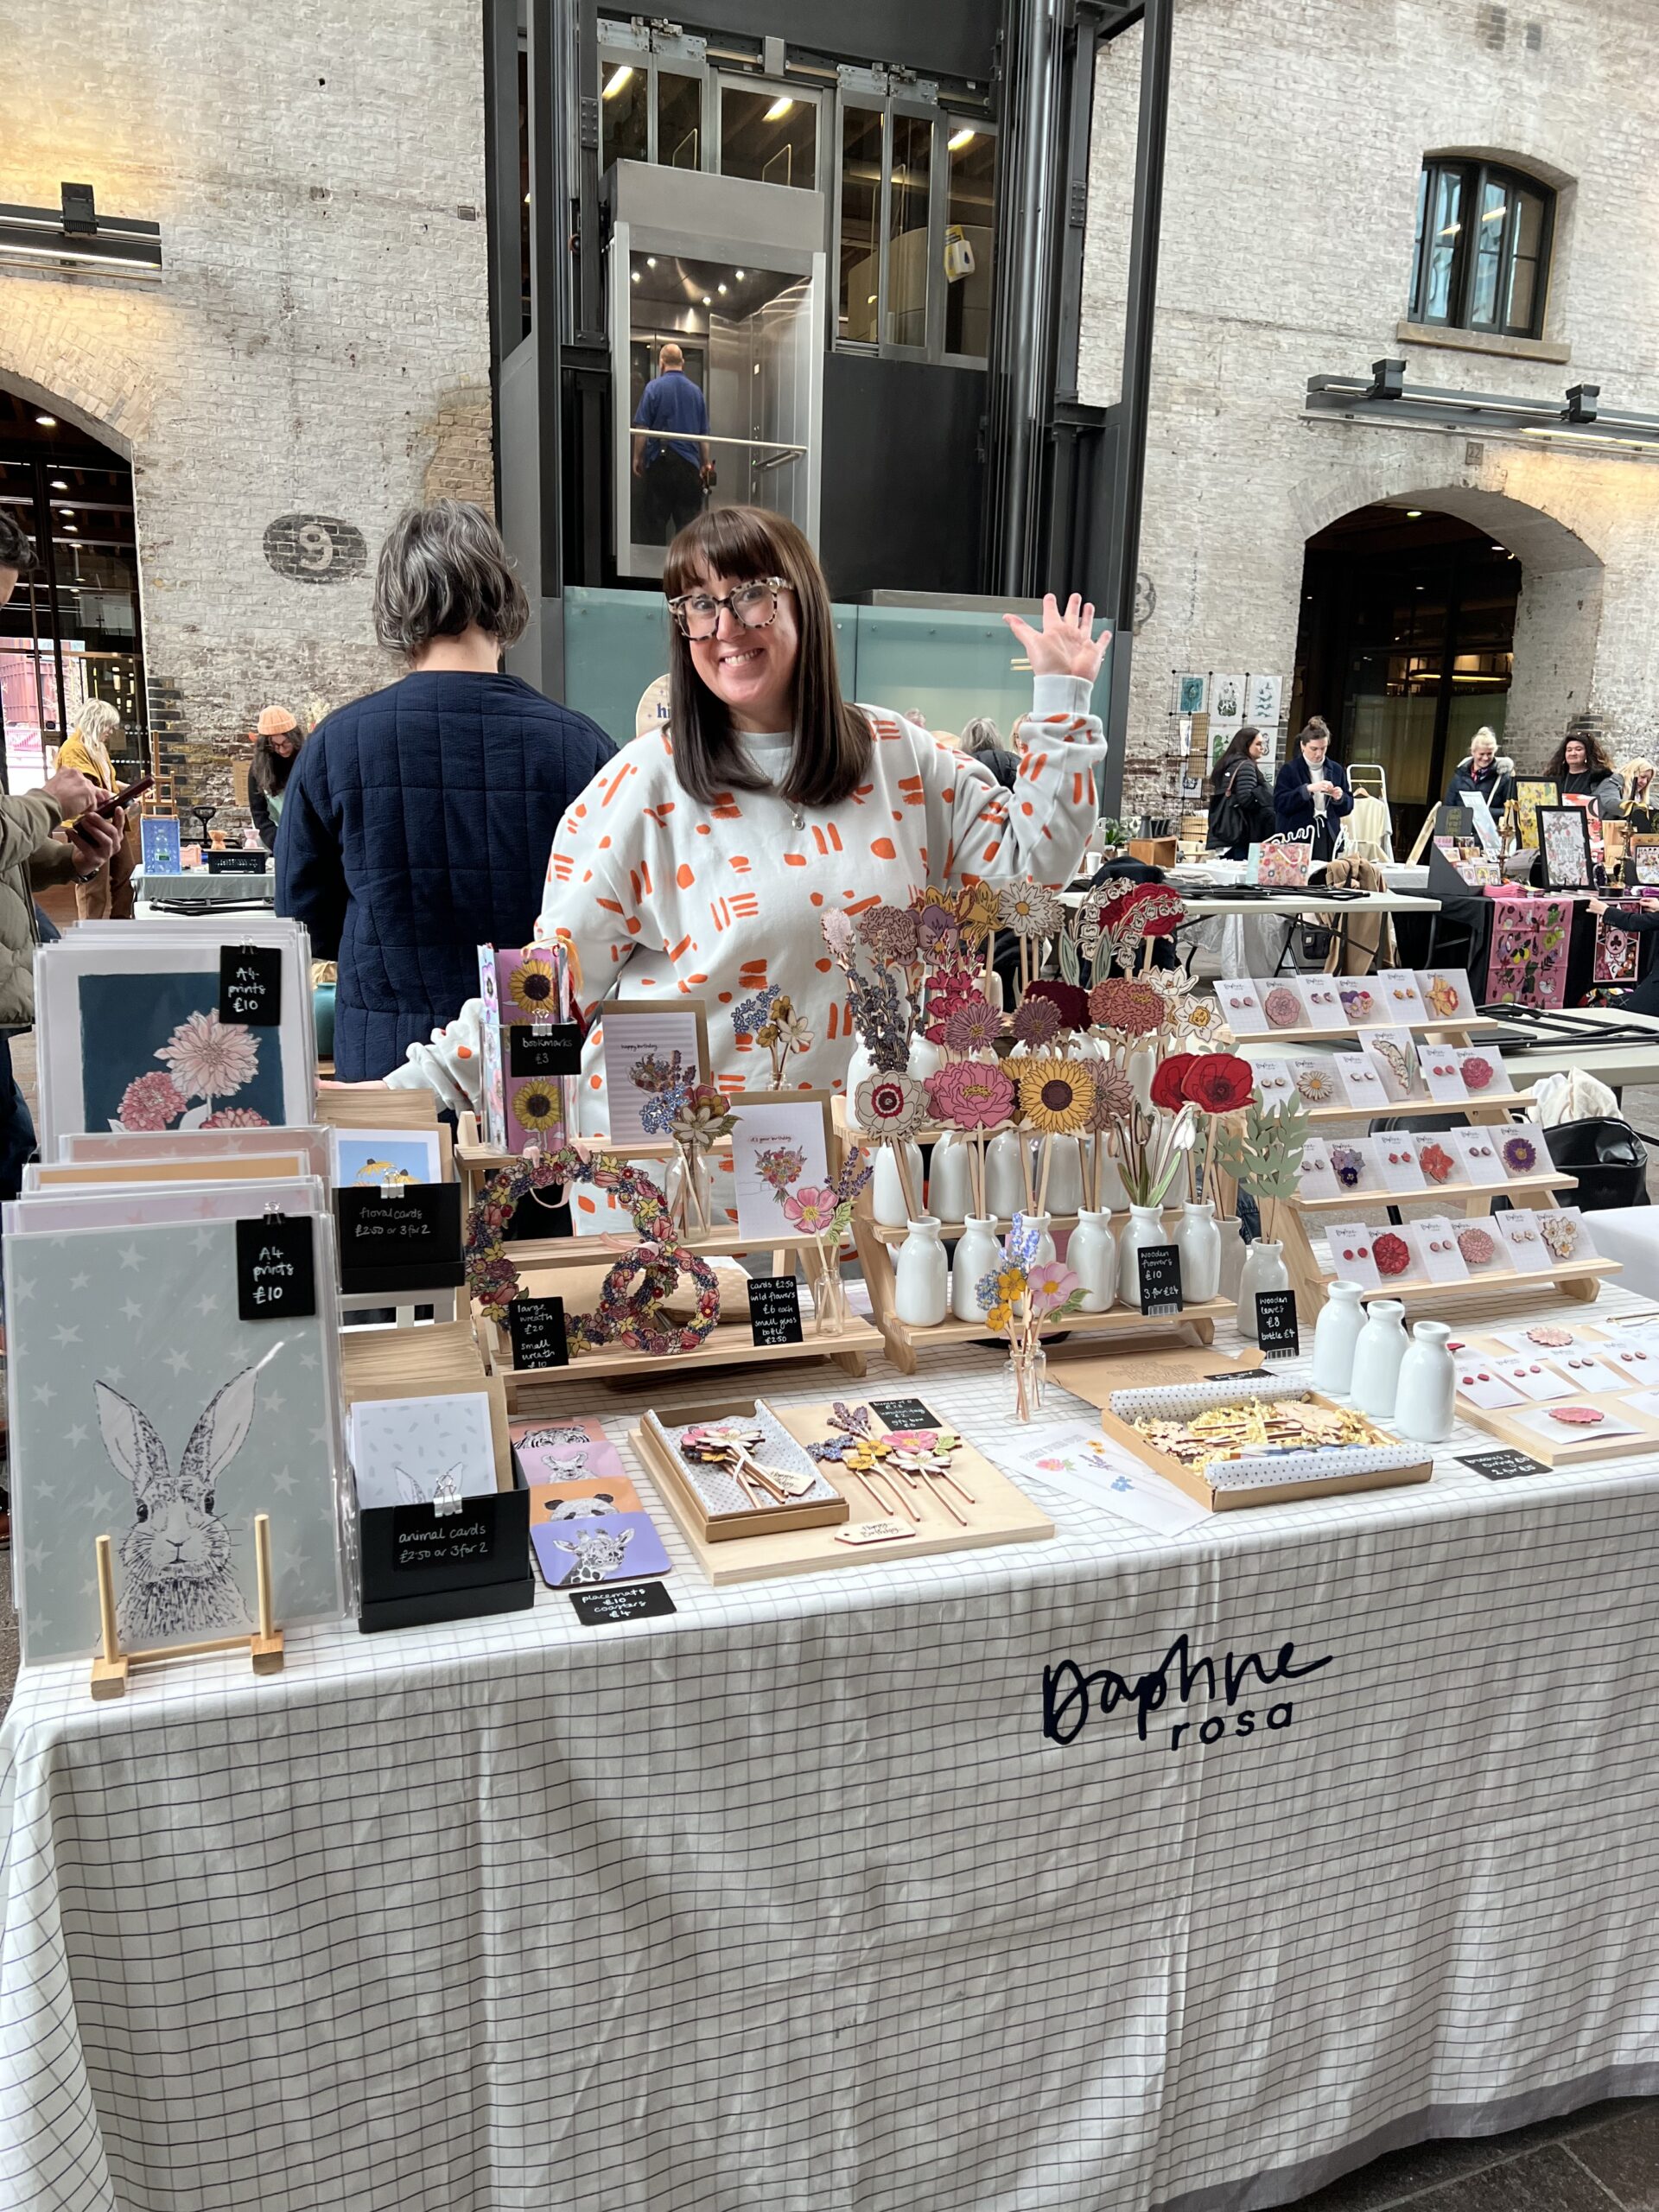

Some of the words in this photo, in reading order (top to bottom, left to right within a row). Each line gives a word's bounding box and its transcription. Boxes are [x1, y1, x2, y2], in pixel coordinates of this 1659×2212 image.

[299, 524, 334, 571] 9
[235, 967, 260, 982] A4
[227, 982, 266, 999] prints
[232, 997, 259, 1013] £10
[535, 1052, 550, 1065] £3
[400, 1225, 407, 1235] 3
[408, 1225, 420, 1237] for
[421, 1224, 431, 1235] 2
[259, 1246, 284, 1261] A4
[252, 1262, 294, 1282] prints
[1145, 1270, 1162, 1281] £10
[252, 1286, 283, 1305] £10
[1143, 1288, 1151, 1300] 3
[1152, 1287, 1163, 1299] for
[763, 1304, 775, 1314] £6
[524, 1324, 544, 1335] £20
[1266, 1317, 1281, 1328] £8
[1283, 1329, 1296, 1338] £4
[521, 1339, 550, 1350] small
[398, 1528, 446, 1543] animal
[449, 1522, 486, 1538] cards
[434, 1548, 448, 1557] or
[450, 1545, 460, 1556] 3
[460, 1543, 478, 1558] for
[480, 1541, 488, 1553] 2
[1043, 1633, 1334, 1745] Daphne
[1171, 1701, 1294, 1751] rosa
